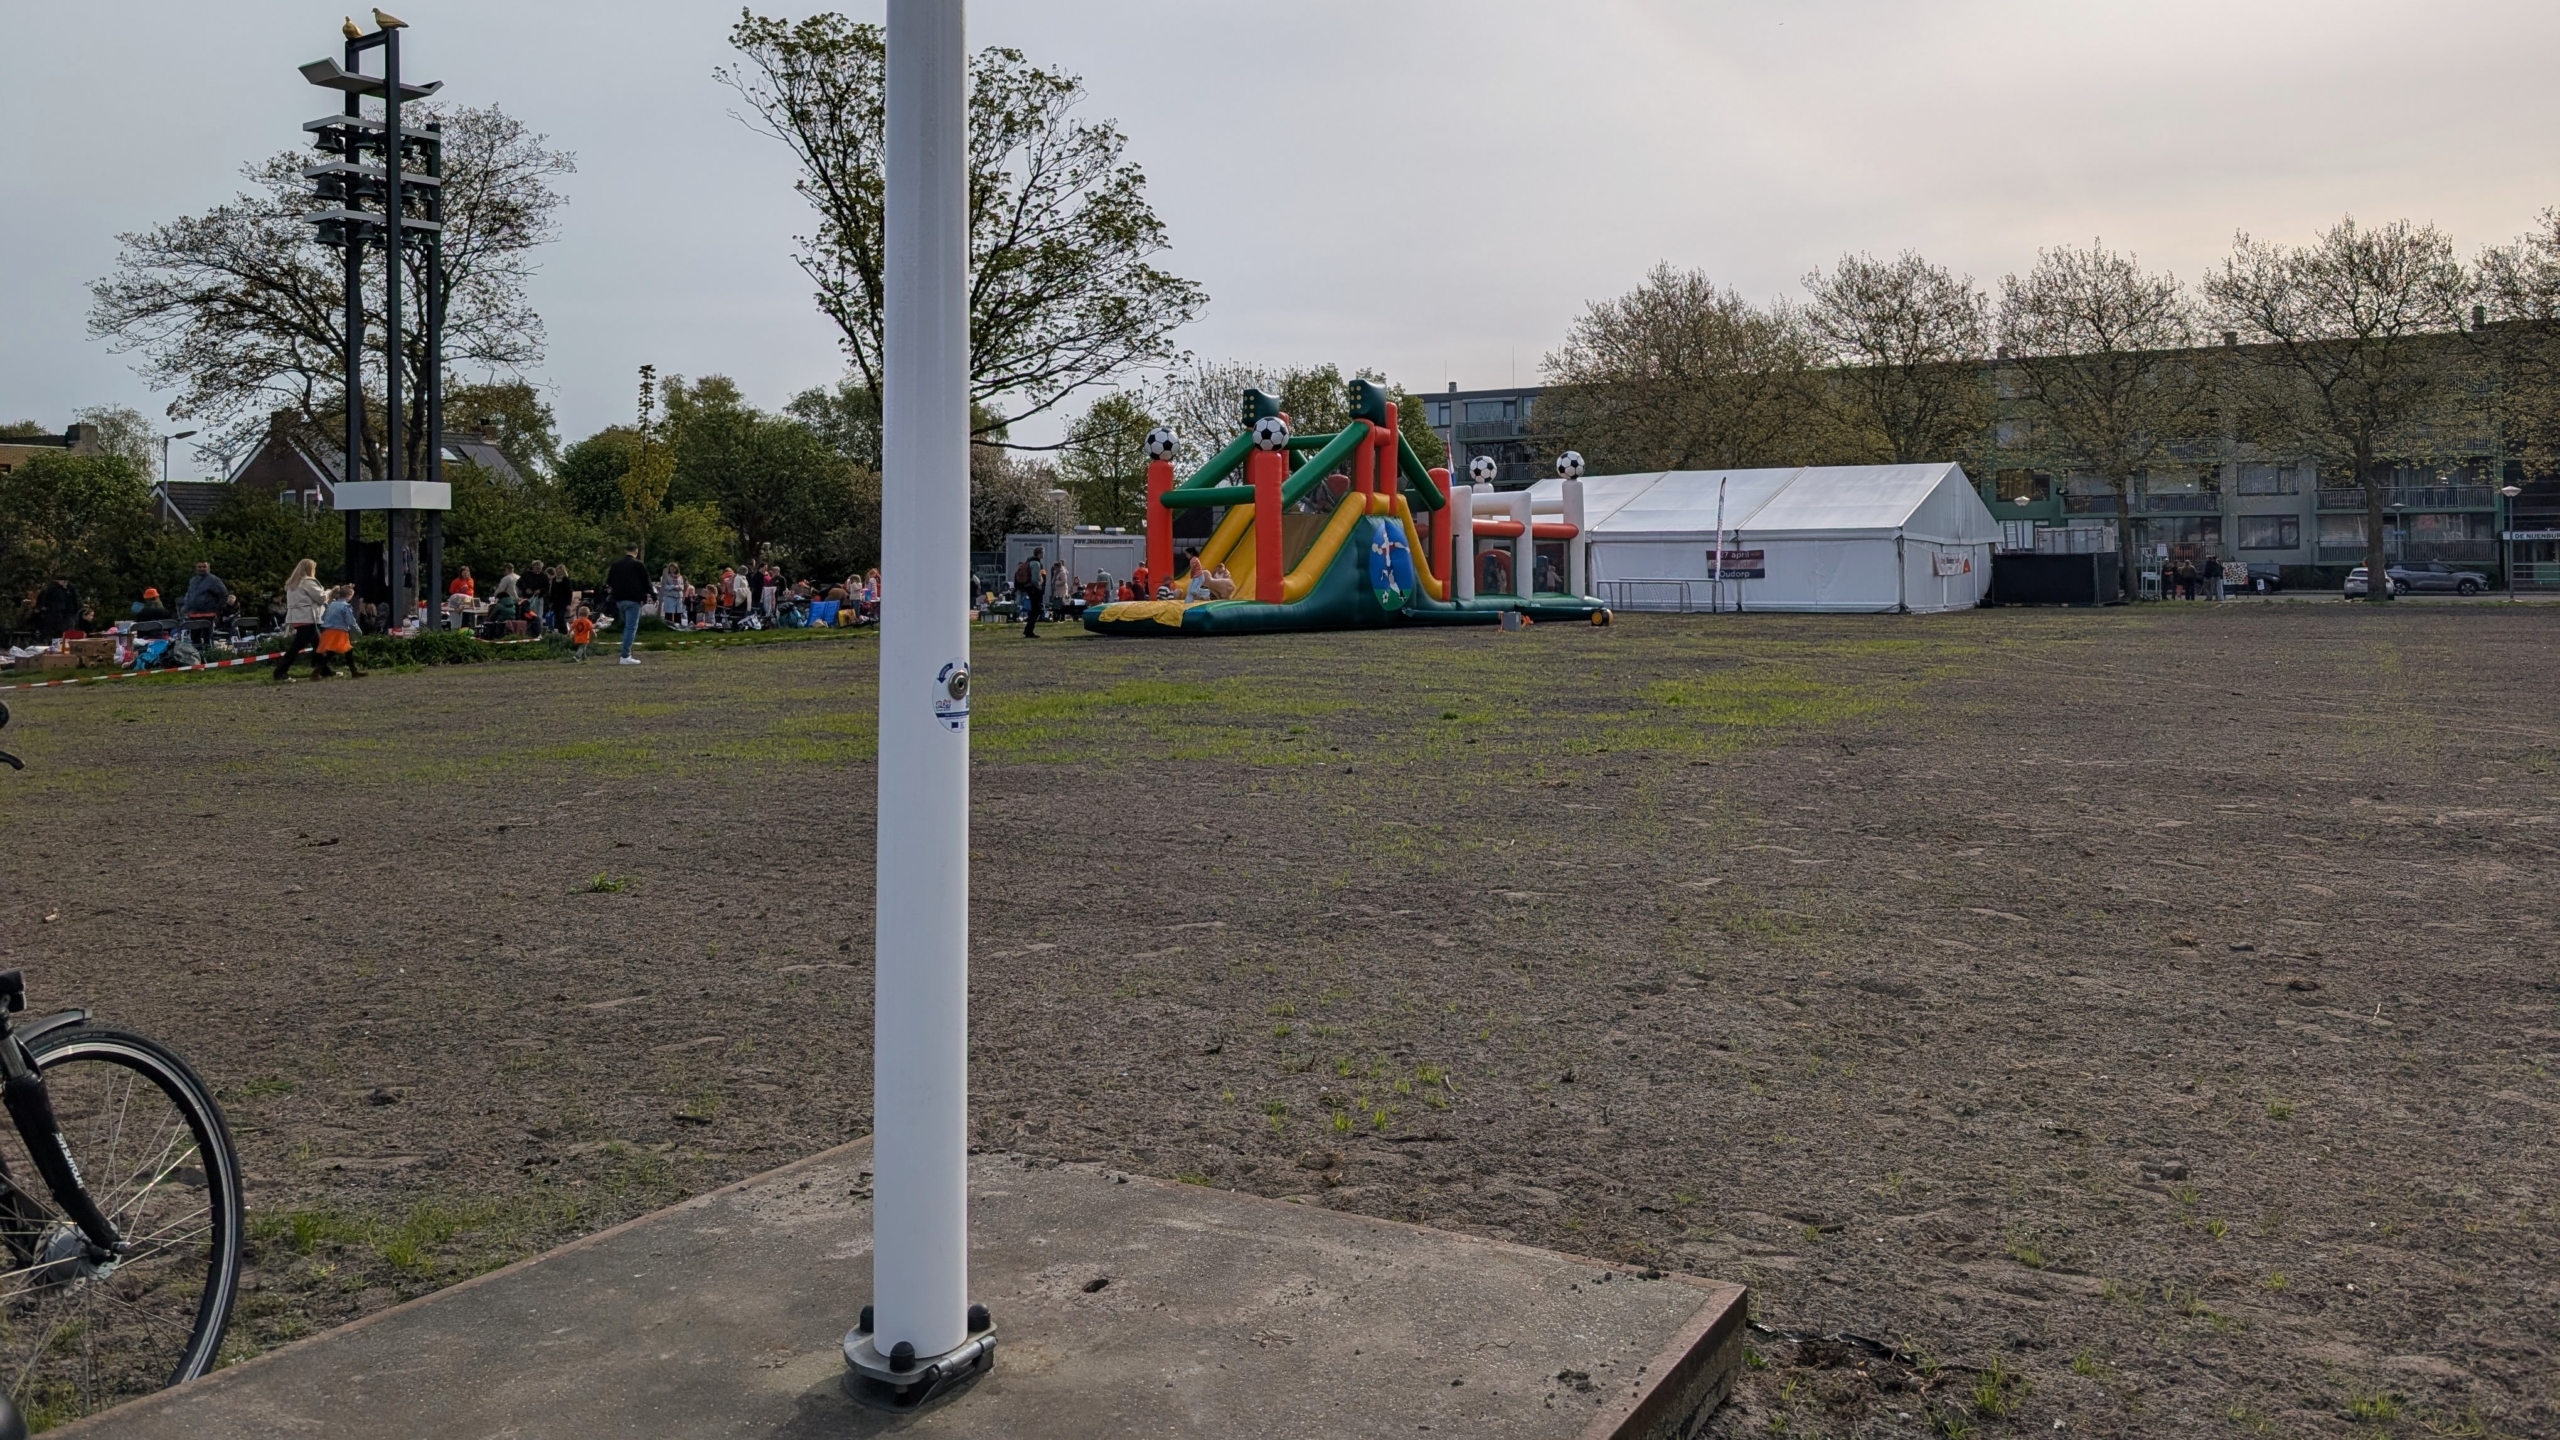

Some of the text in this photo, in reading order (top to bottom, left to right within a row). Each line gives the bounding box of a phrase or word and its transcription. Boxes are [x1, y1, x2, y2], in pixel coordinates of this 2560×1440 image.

[1720, 551, 1729, 559] 27
[1731, 551, 1750, 559] april
[1720, 570, 1750, 578] Oudorp
